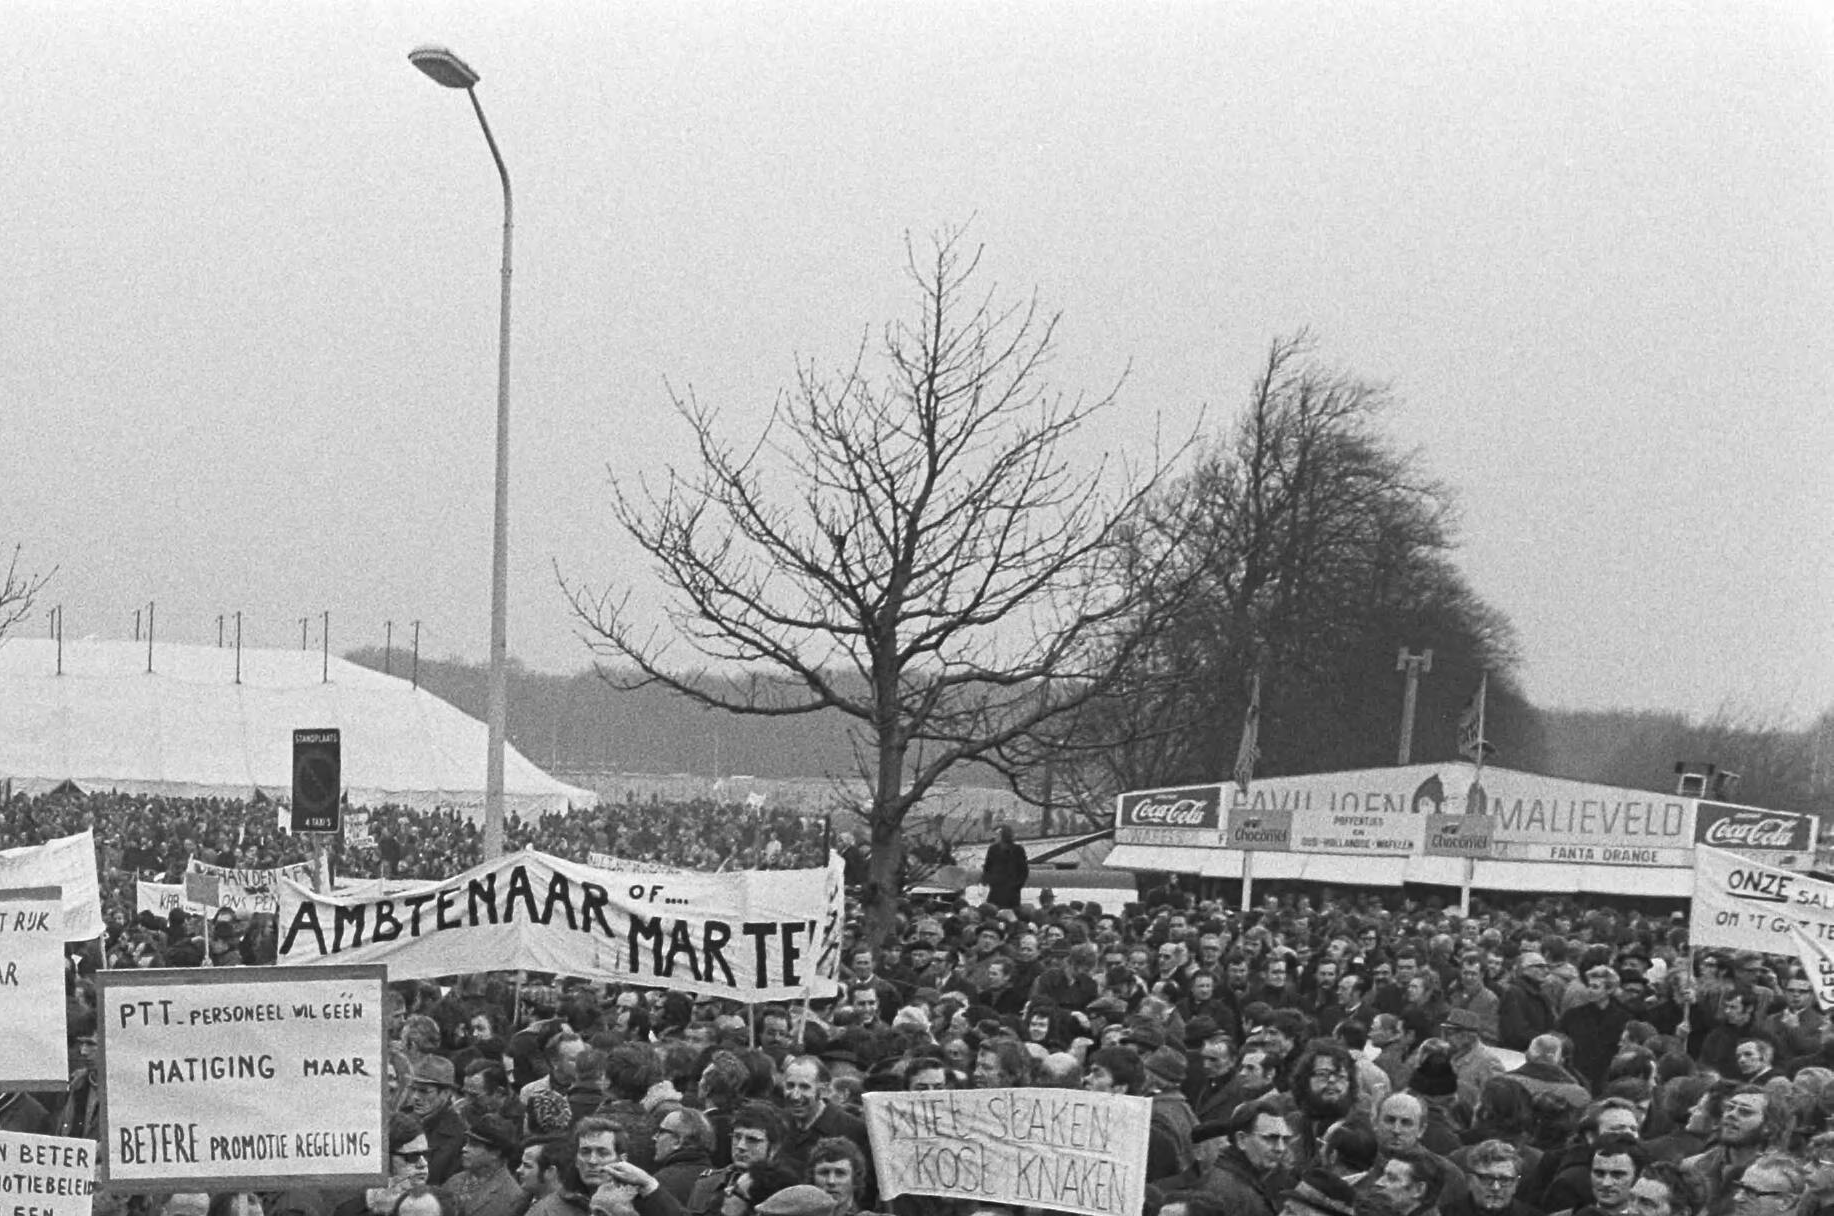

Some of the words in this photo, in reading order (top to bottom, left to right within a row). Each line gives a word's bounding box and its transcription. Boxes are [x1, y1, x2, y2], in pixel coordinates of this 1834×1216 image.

[1494, 798, 1683, 836] MALIEVELD
[1550, 847, 1595, 860] FANTA
[1603, 849, 1658, 863] ORANGE
[1727, 869, 1795, 898] ONZE
[279, 865, 616, 956] AMBTENAAR
[1717, 911, 1739, 927] OM
[292, 1004, 317, 1020] WIL
[148, 1055, 275, 1085] MATIGING
[303, 1057, 372, 1078] MAAR
[19, 1144, 89, 1169] BETER
[120, 1123, 200, 1165] BETERE
[210, 1133, 289, 1161] PROMOTIE
[295, 1131, 370, 1158] REGELING
[1017, 1151, 1129, 1213] KNAKEN
